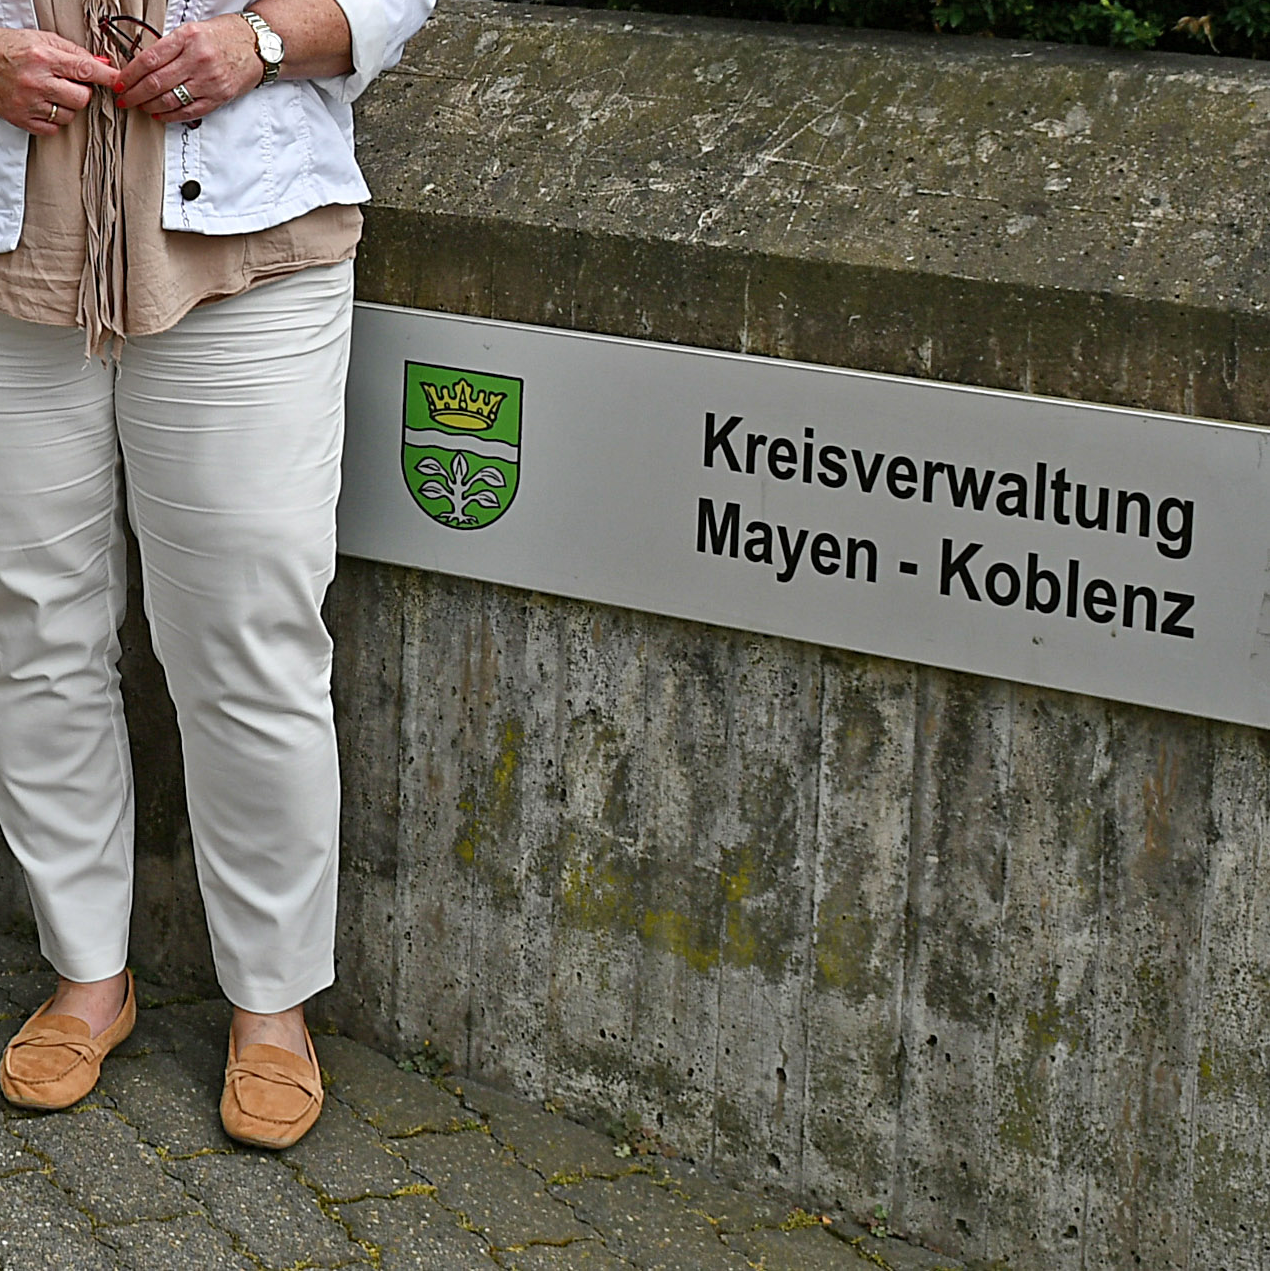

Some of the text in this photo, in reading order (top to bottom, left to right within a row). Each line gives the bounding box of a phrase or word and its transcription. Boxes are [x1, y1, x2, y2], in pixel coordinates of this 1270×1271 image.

[702, 412, 1194, 559] Kreisverwaltung
[695, 497, 1195, 639] Mayen - Koblenz
